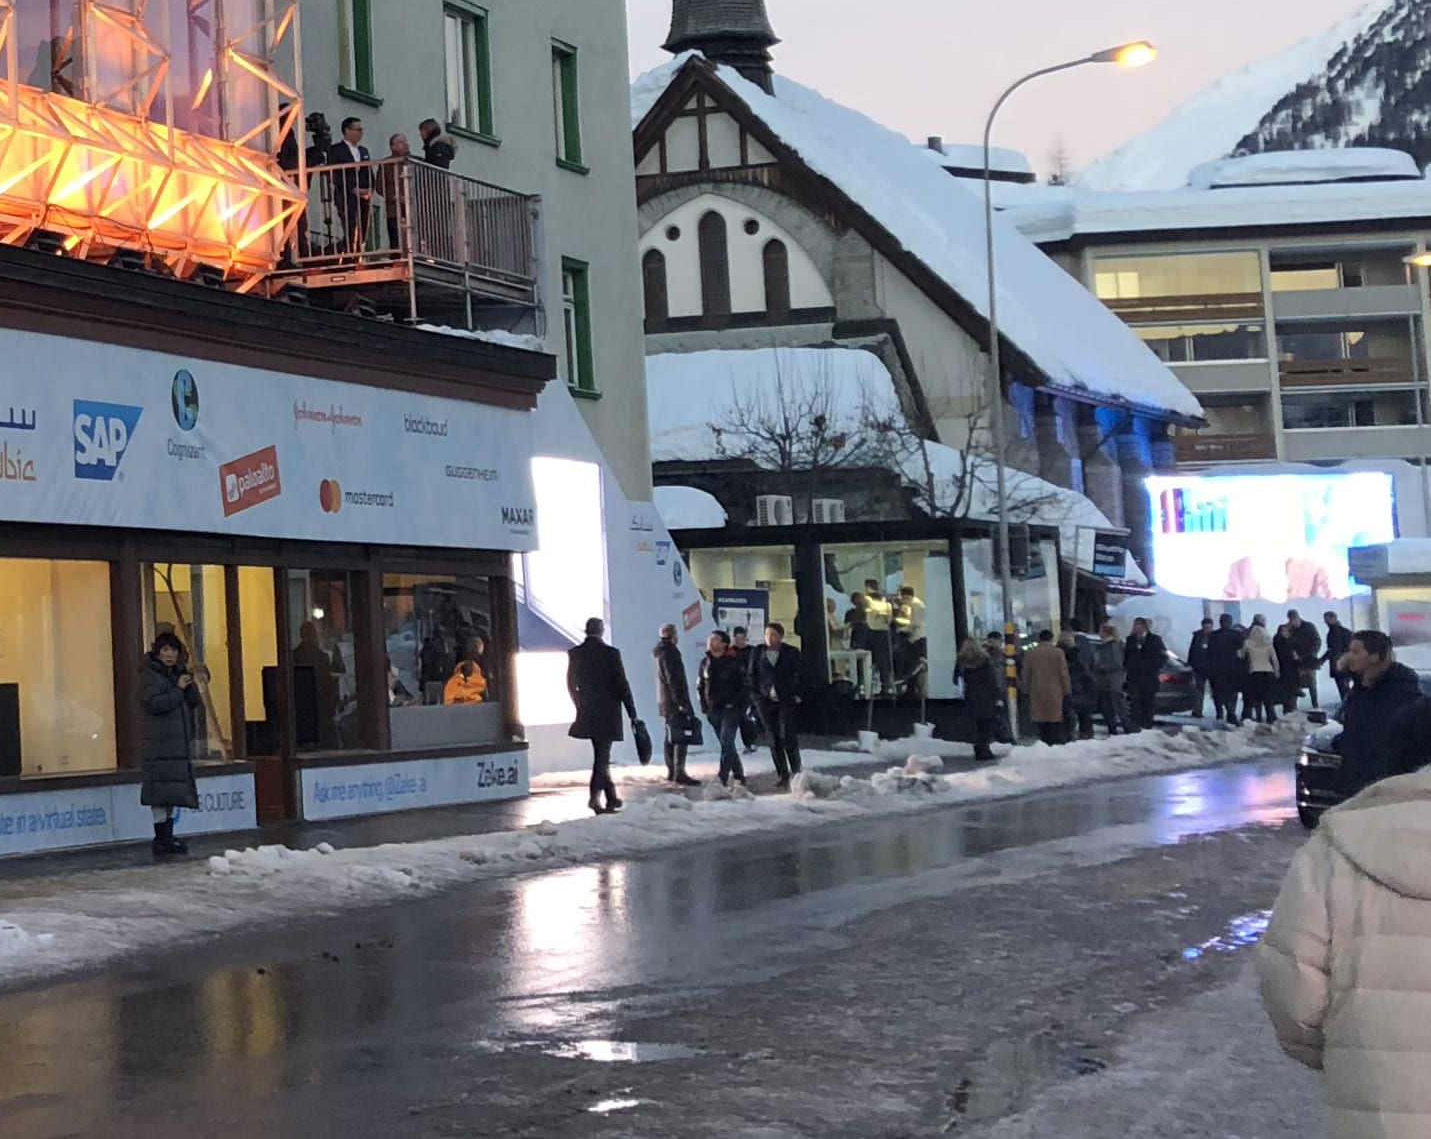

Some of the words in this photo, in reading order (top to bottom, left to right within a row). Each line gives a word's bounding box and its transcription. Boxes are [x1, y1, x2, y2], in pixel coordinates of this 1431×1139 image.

[404, 413, 448, 437] blackbaud
[74, 413, 128, 467] SAP
[345, 491, 394, 508] mastercard
[501, 506, 535, 526] MAXAR
[477, 759, 518, 788] Zeke.ai
